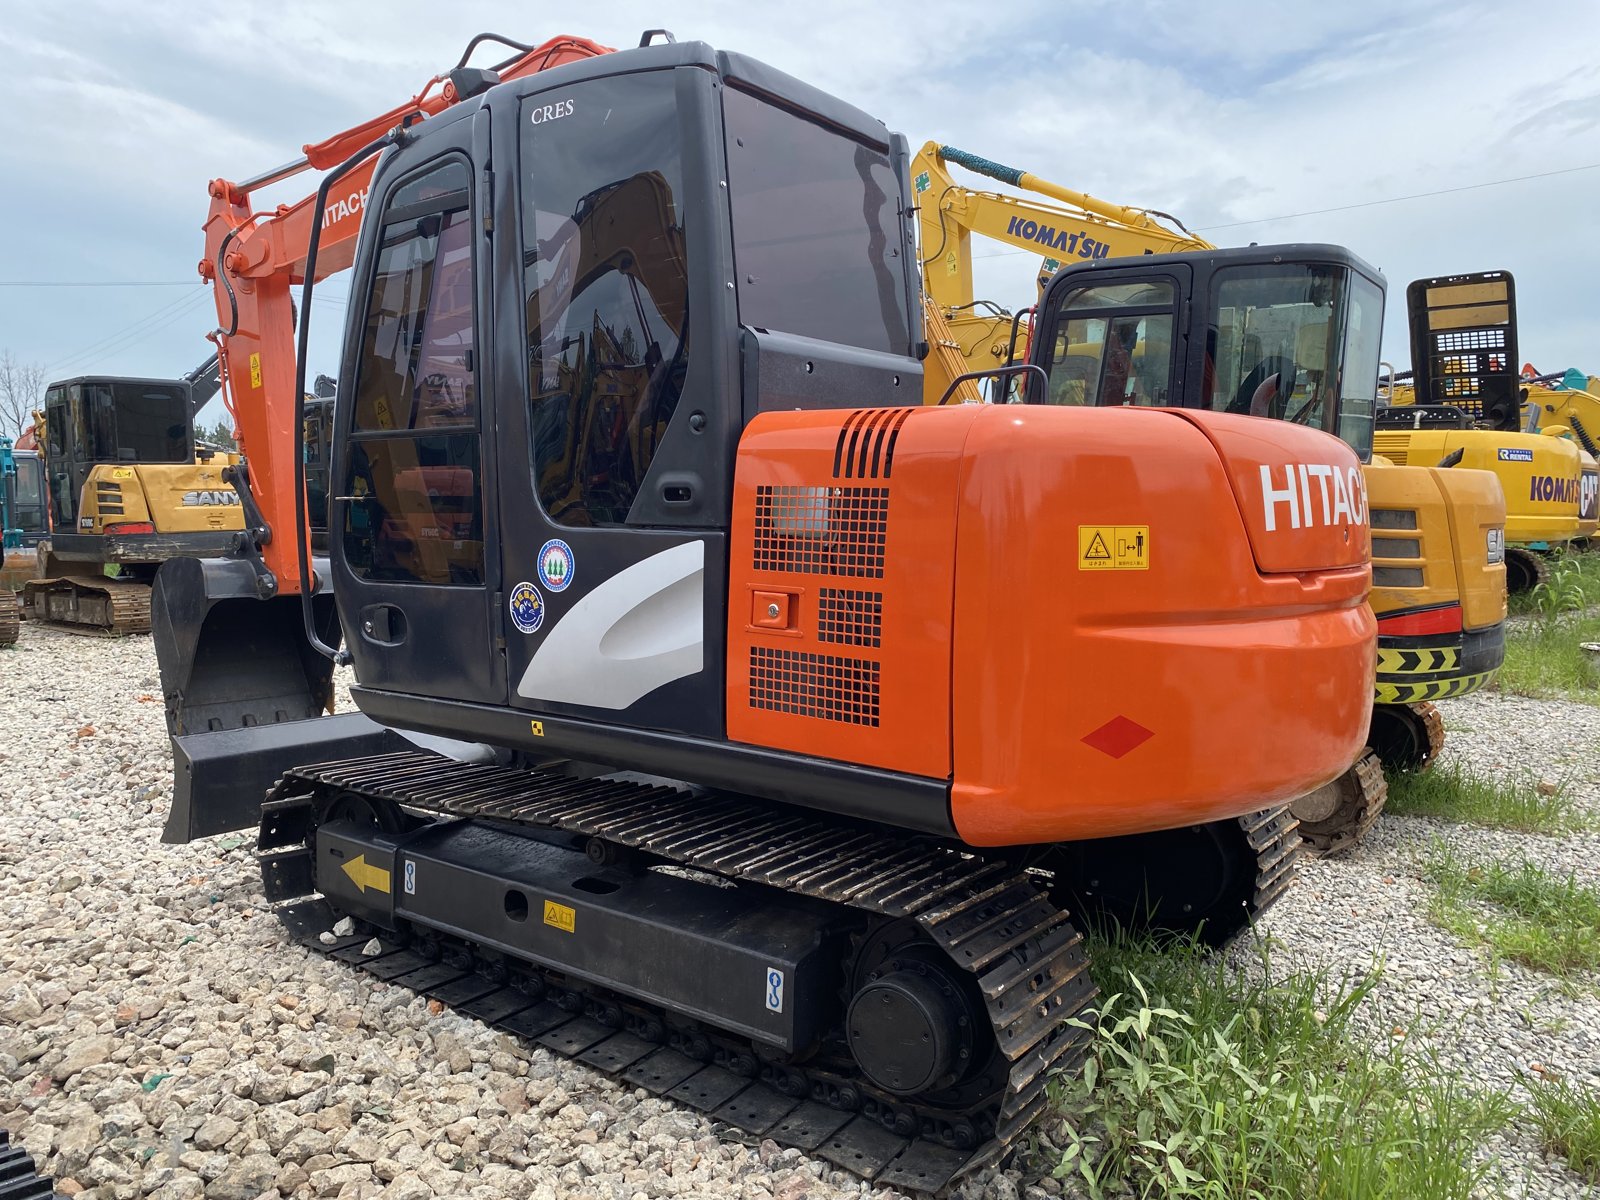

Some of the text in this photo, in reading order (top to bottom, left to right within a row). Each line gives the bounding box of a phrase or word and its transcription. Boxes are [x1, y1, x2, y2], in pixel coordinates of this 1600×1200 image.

[531, 99, 574, 125] CRES
[1007, 215, 1111, 259] KOMATSU
[182, 490, 240, 506] SANY
